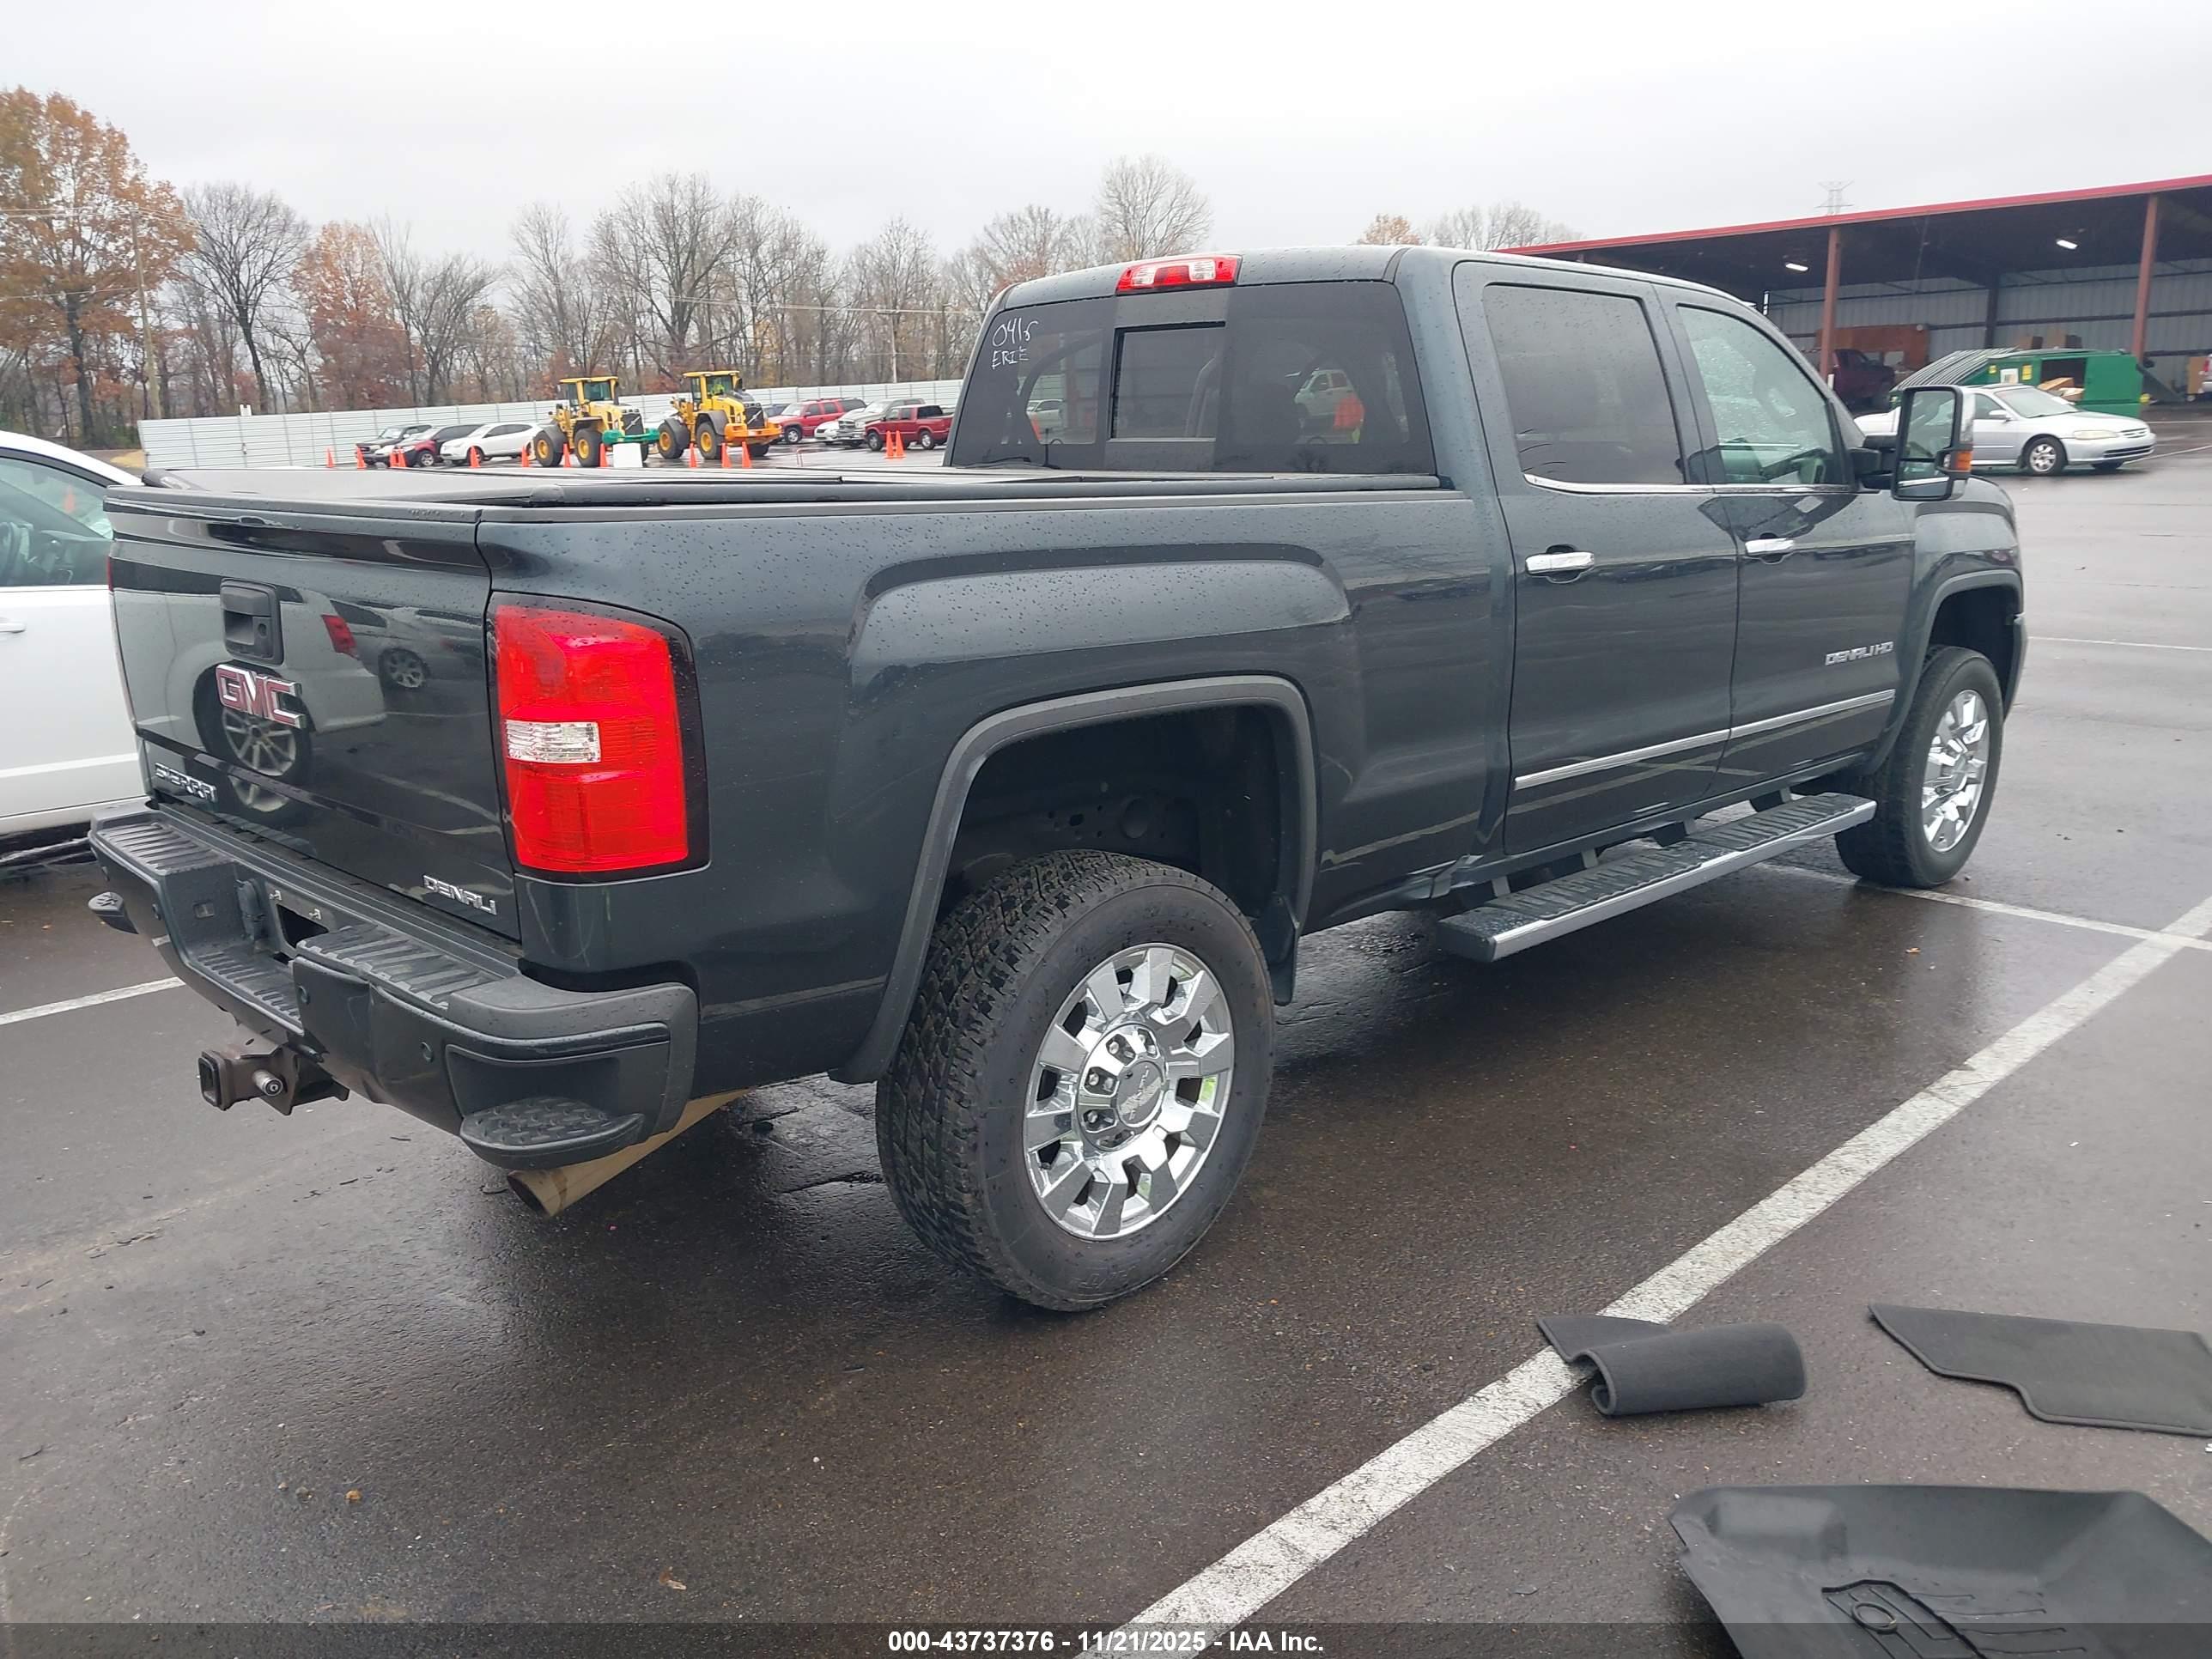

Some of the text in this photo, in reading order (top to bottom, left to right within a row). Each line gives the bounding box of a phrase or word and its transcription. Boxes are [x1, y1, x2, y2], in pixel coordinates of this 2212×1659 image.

[1825, 641, 1894, 665] DENALI HD
[216, 664, 307, 729] GMC
[155, 762, 218, 803] SIERRA
[422, 874, 498, 915] DENALI
